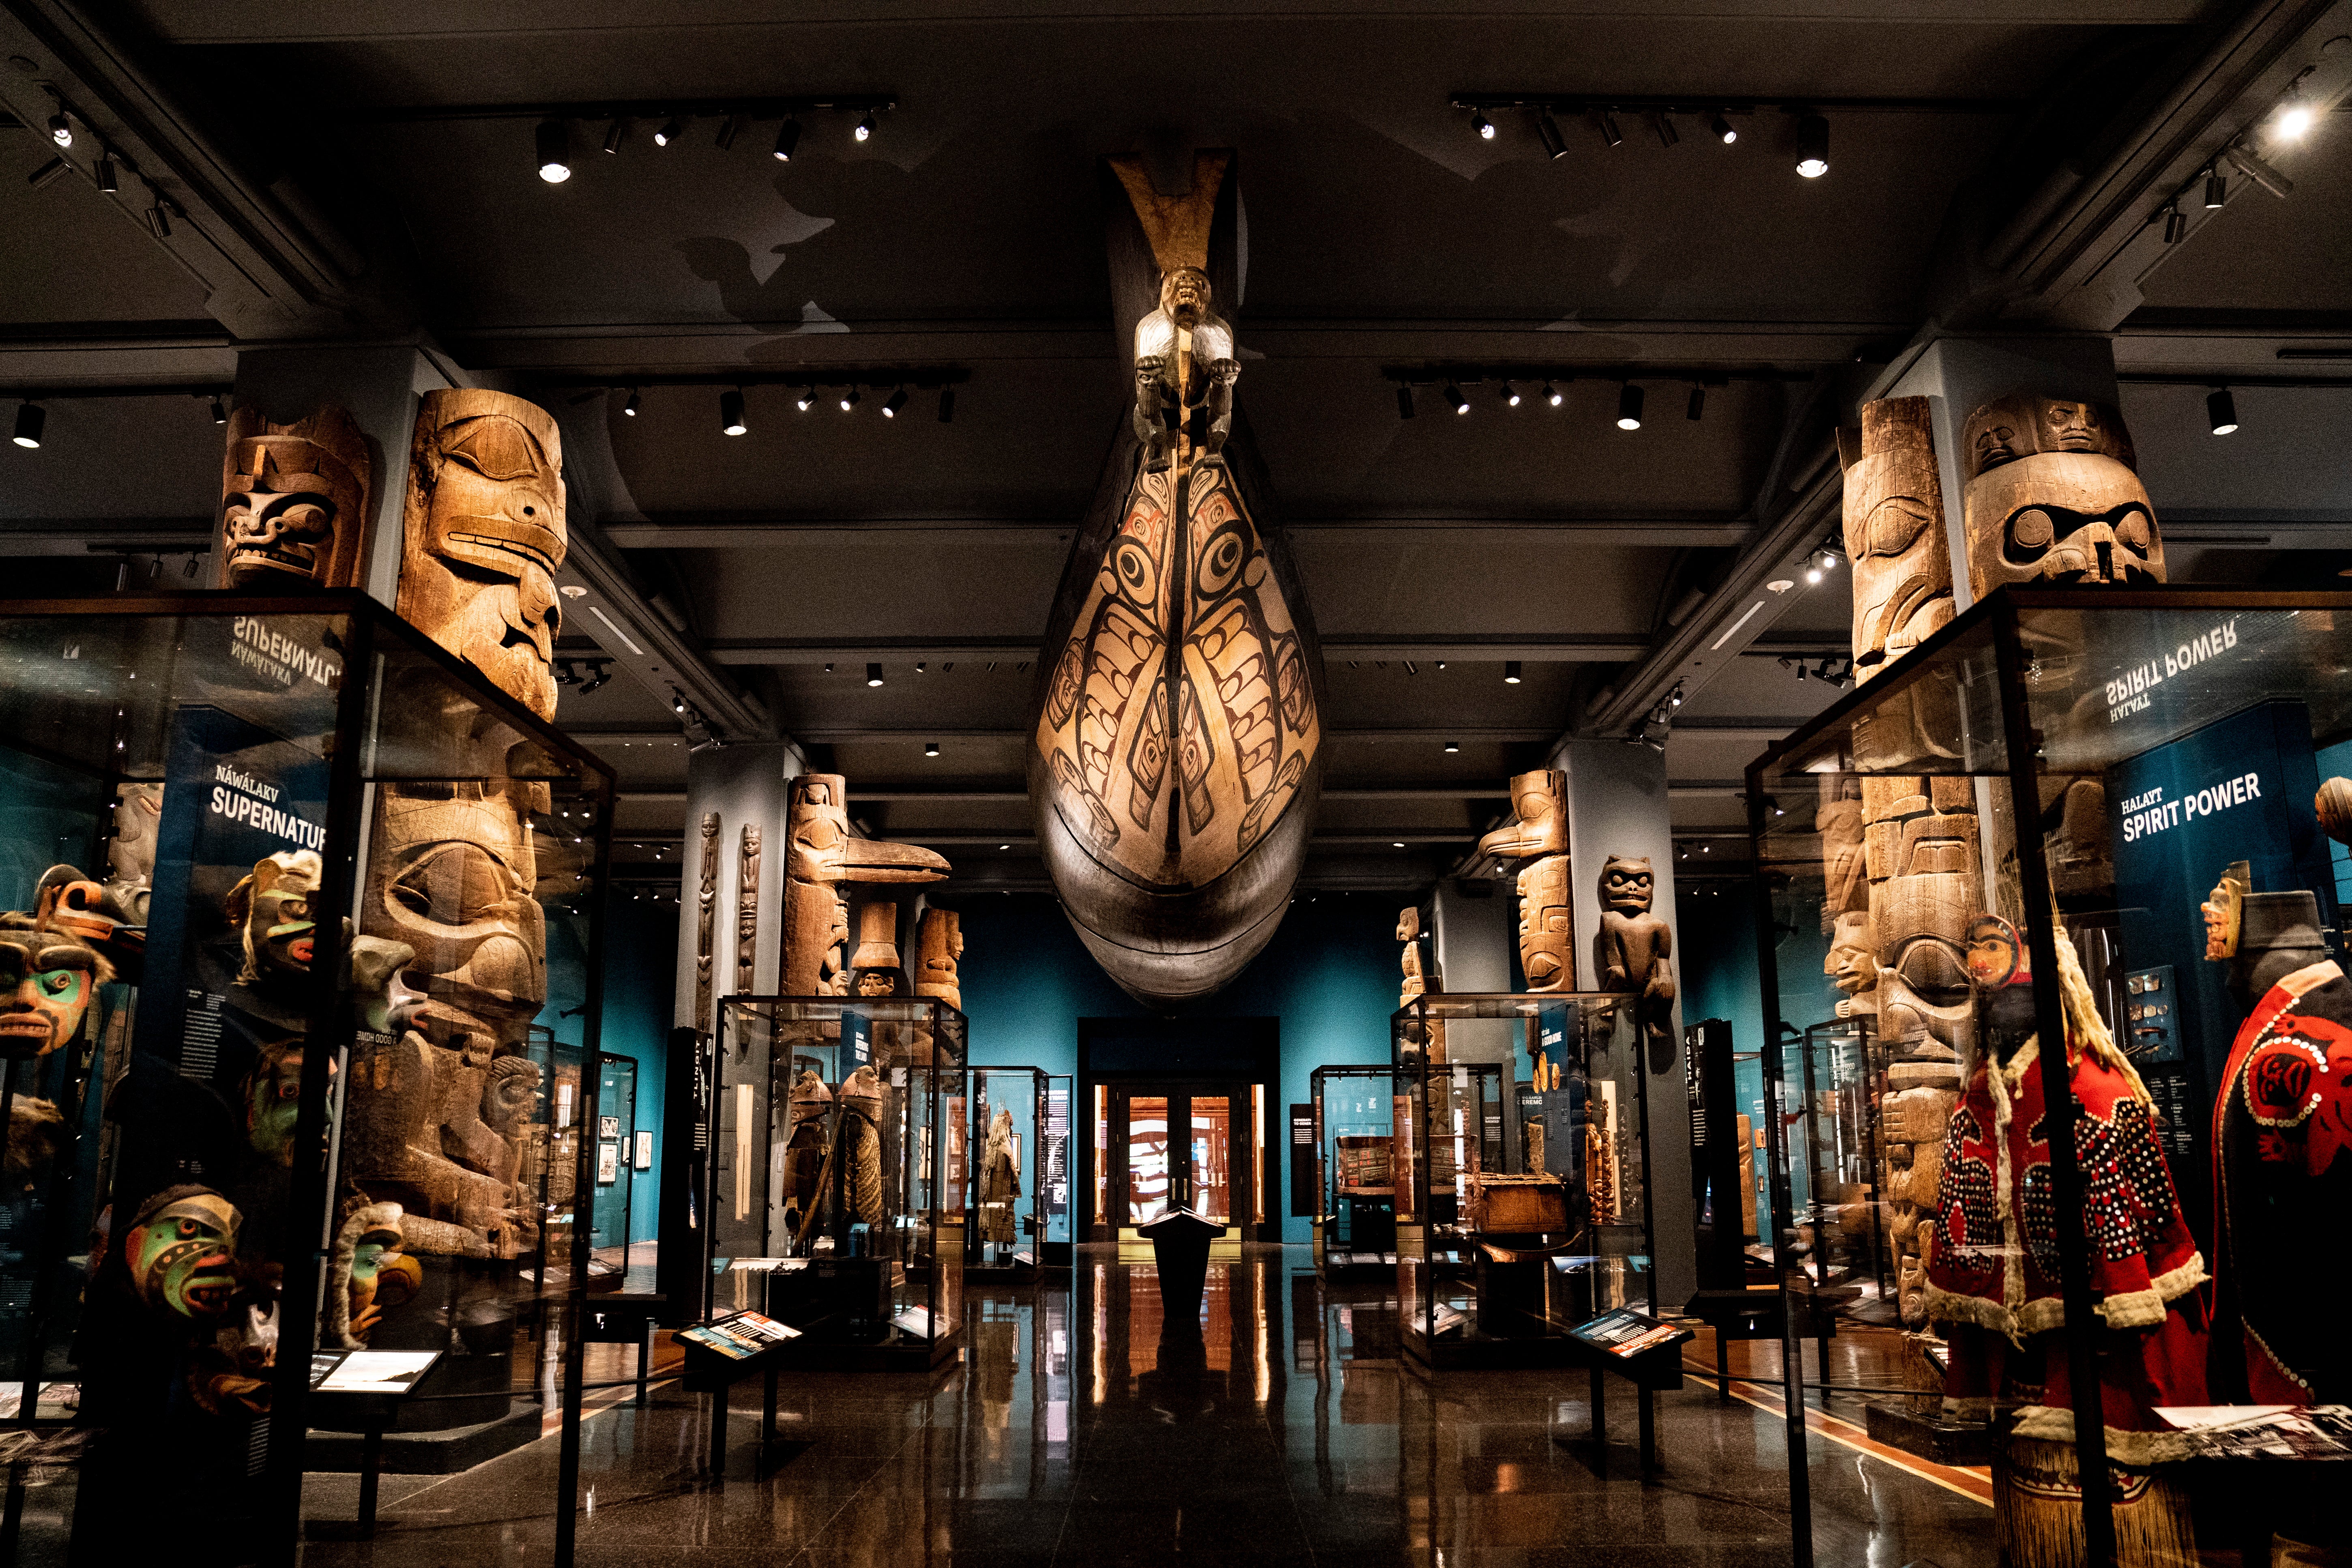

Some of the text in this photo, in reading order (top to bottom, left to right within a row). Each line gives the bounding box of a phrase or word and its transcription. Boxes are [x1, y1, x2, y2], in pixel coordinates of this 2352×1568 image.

[2121, 787, 2162, 815] HALAYT
[2123, 773, 2261, 842] SPIRIT POWER
[1544, 1035, 1553, 1046] GOOD
